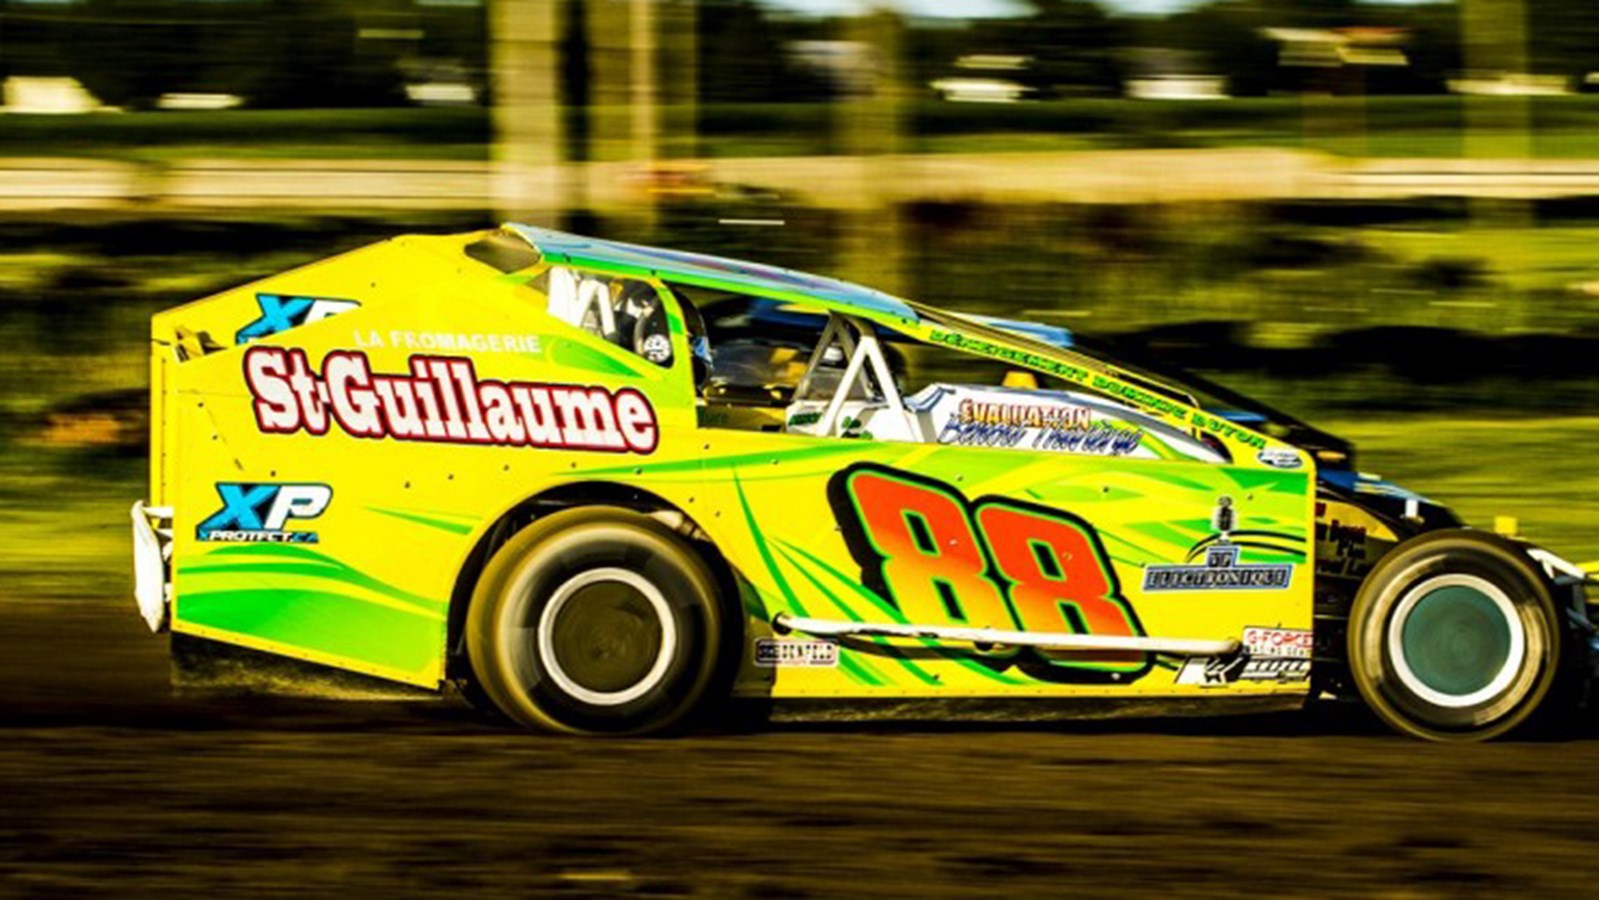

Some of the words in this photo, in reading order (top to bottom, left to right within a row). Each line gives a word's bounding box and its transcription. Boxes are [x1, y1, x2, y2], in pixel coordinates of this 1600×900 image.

[353, 330, 382, 347] LA
[389, 330, 541, 353] FROMAGERIE
[196, 482, 334, 531] XP
[826, 461, 1150, 685] 88
